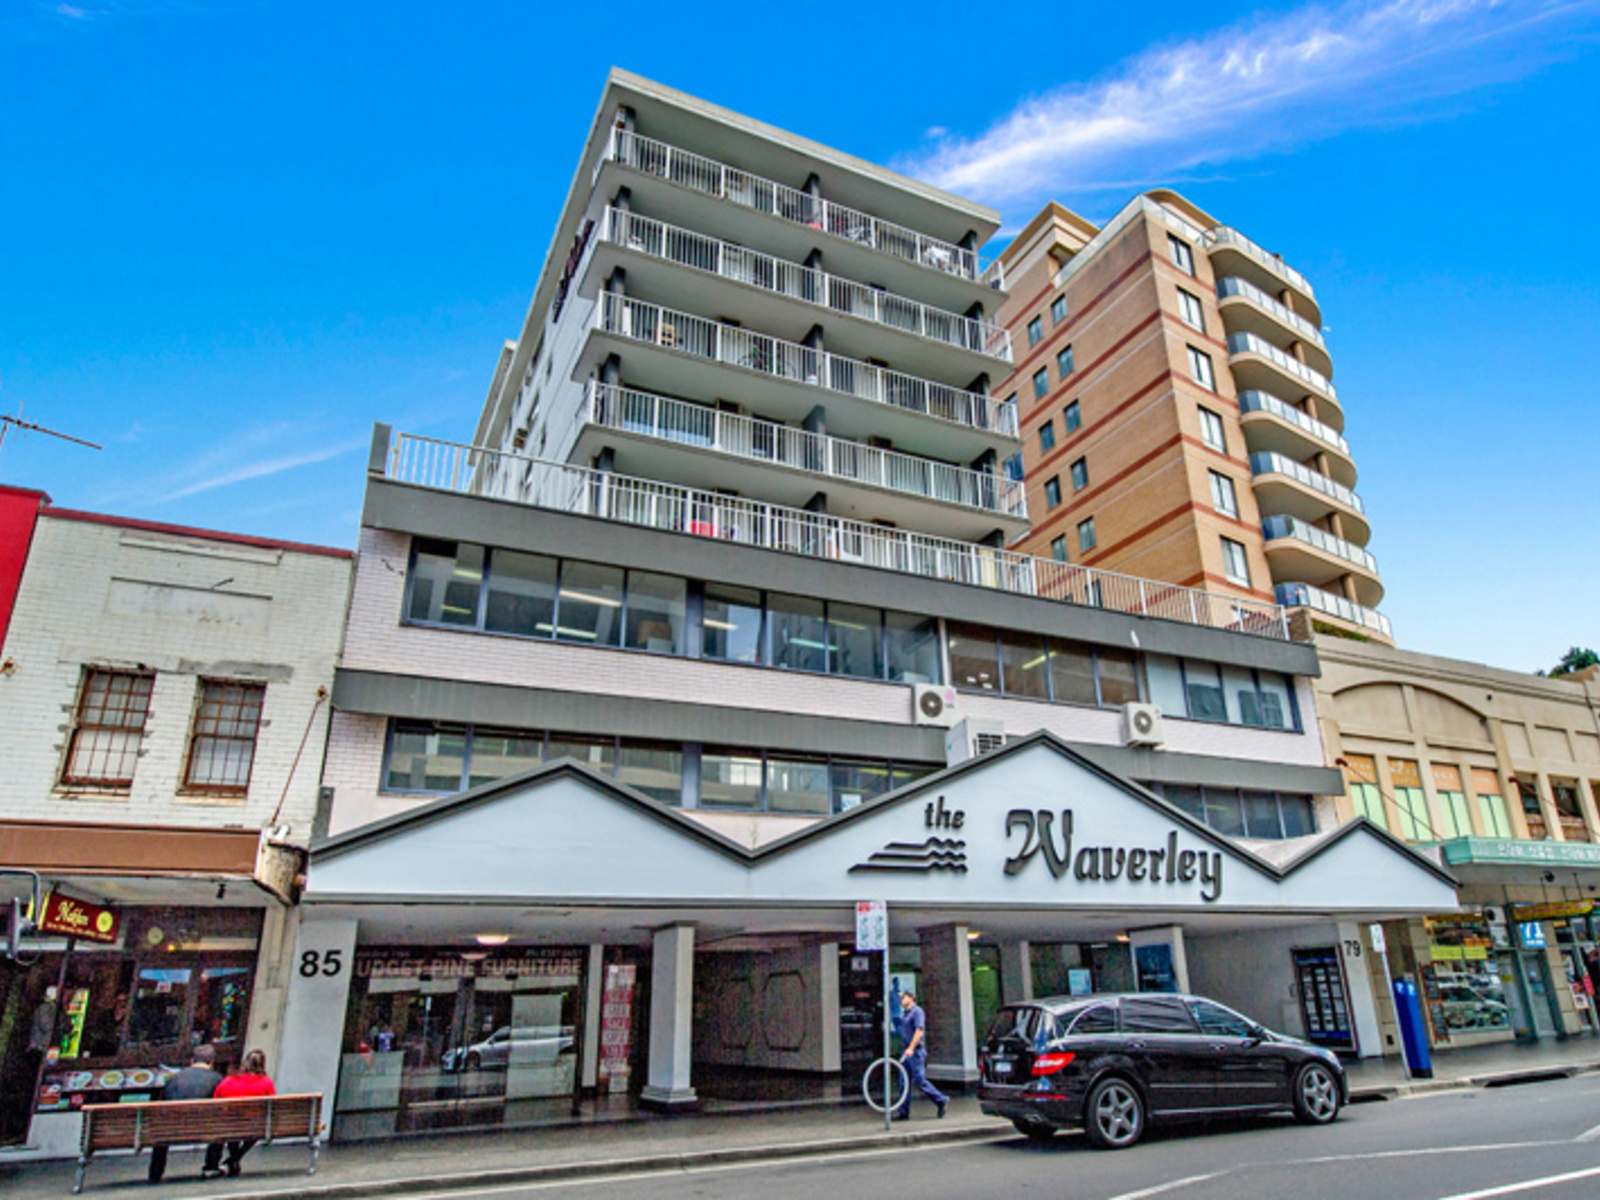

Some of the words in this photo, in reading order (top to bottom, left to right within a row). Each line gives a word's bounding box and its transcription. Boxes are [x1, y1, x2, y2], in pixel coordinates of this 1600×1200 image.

[925, 796, 965, 829] the
[1002, 808, 1222, 902] Waverley
[1343, 939, 1361, 957] 79
[299, 949, 342, 978] 85
[357, 958, 426, 978] UDGET
[430, 958, 476, 977] PINE
[482, 957, 584, 976] FURNITURE
